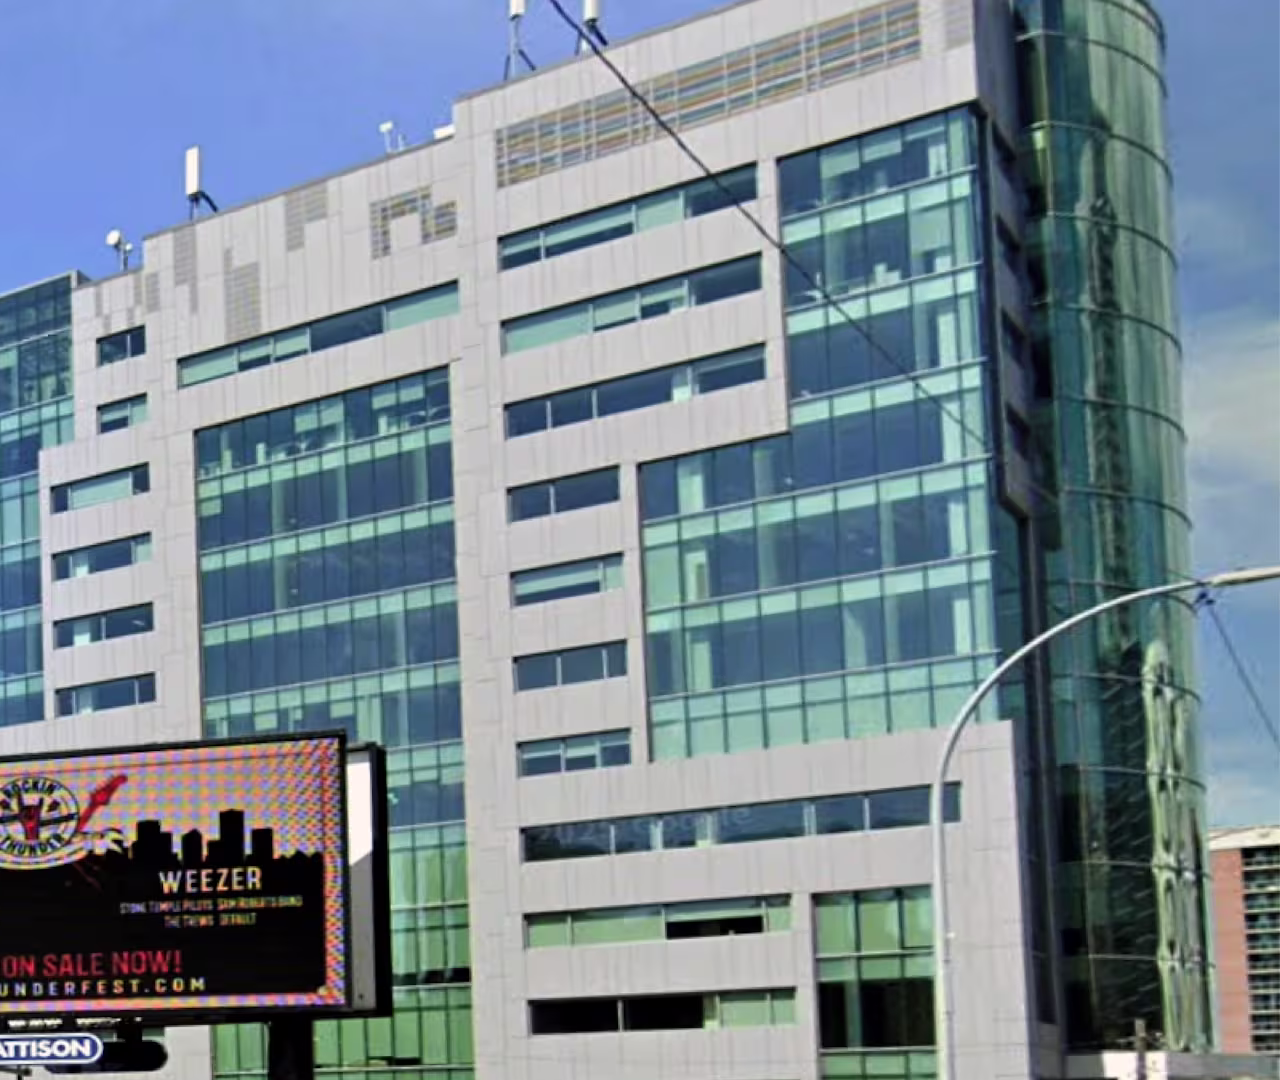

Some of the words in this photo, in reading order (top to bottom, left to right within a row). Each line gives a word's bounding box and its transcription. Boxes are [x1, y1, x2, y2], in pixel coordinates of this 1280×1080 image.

[158, 865, 263, 894] WEEZER
[2, 954, 36, 979] ON
[42, 951, 105, 977] SALE
[111, 949, 183, 976] NOW!
